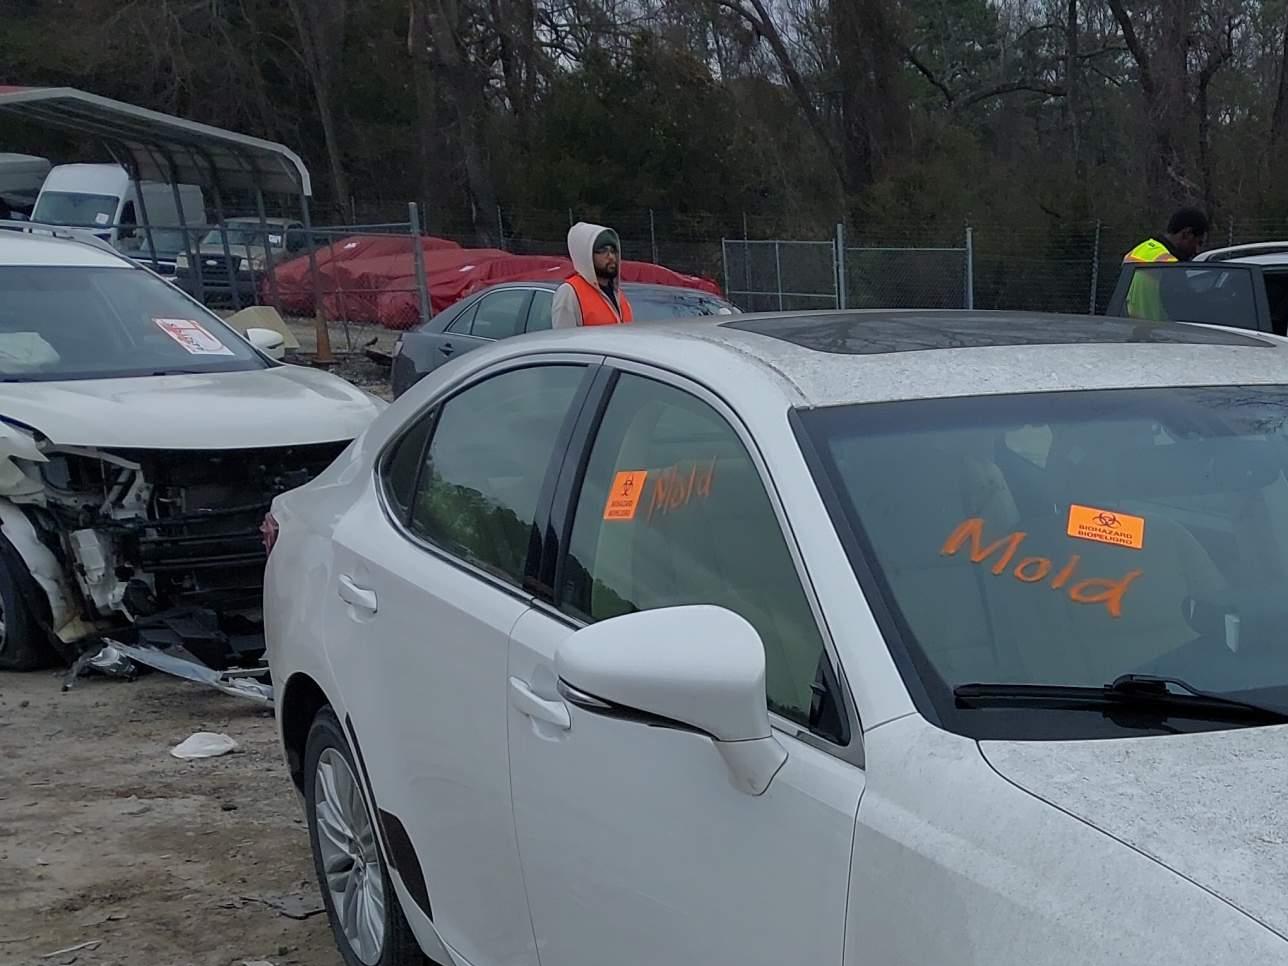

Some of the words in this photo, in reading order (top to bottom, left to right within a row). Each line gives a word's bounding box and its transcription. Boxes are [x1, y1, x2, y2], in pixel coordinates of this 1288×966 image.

[1077, 530, 1133, 545] BIOPELIGRO
[1078, 524, 1133, 539] BIOHAZARD
[939, 516, 1142, 619] Mold
